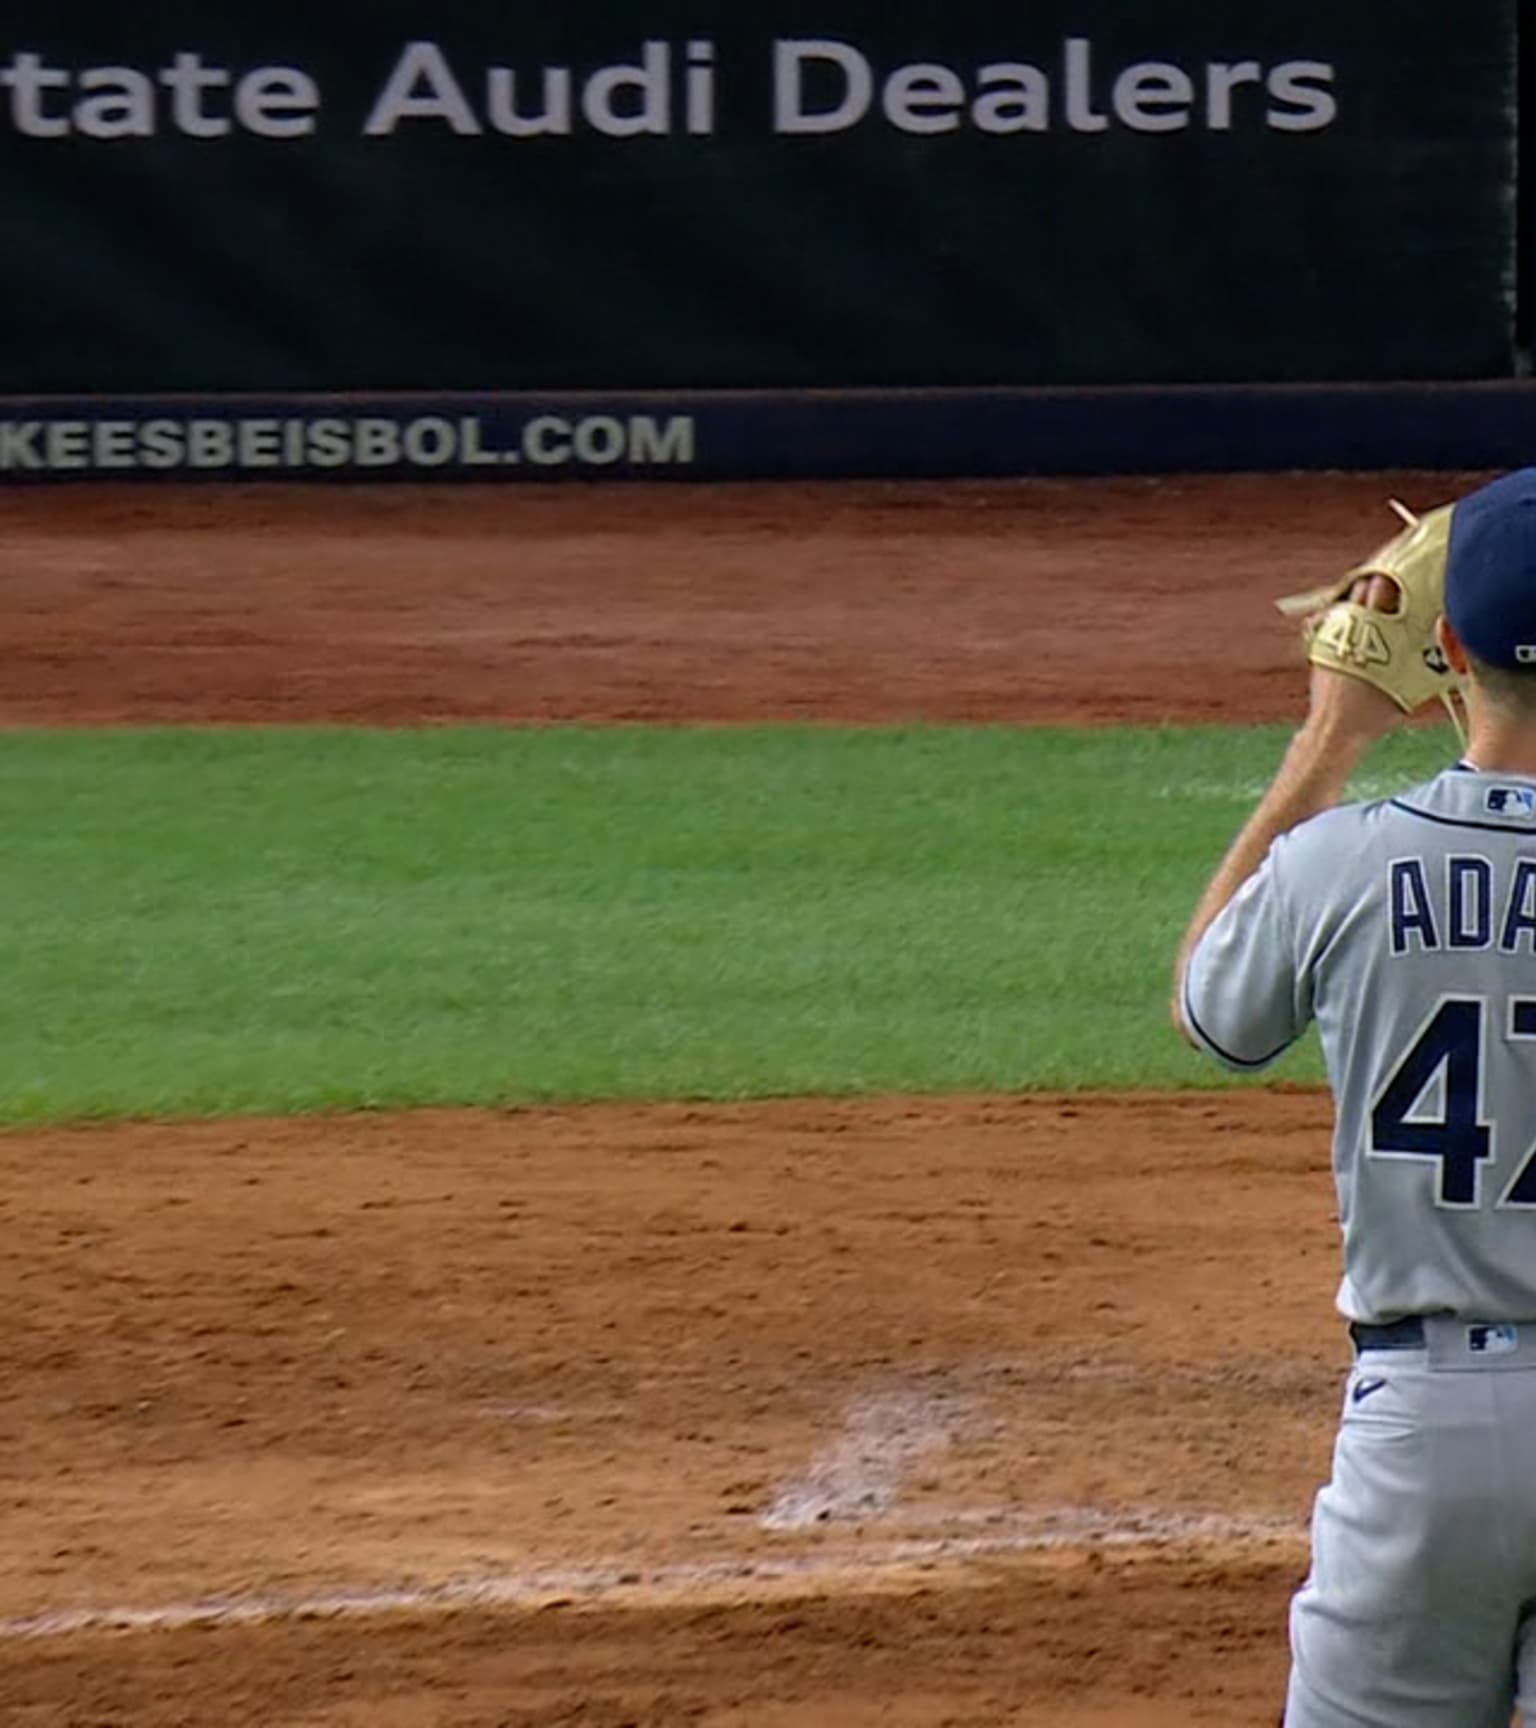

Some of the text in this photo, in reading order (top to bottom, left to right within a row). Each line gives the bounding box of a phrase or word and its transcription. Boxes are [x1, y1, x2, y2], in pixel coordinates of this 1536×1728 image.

[0, 38, 1338, 137] tate Audi Dealers
[0, 416, 695, 468] KEESBEISBOL.COM
